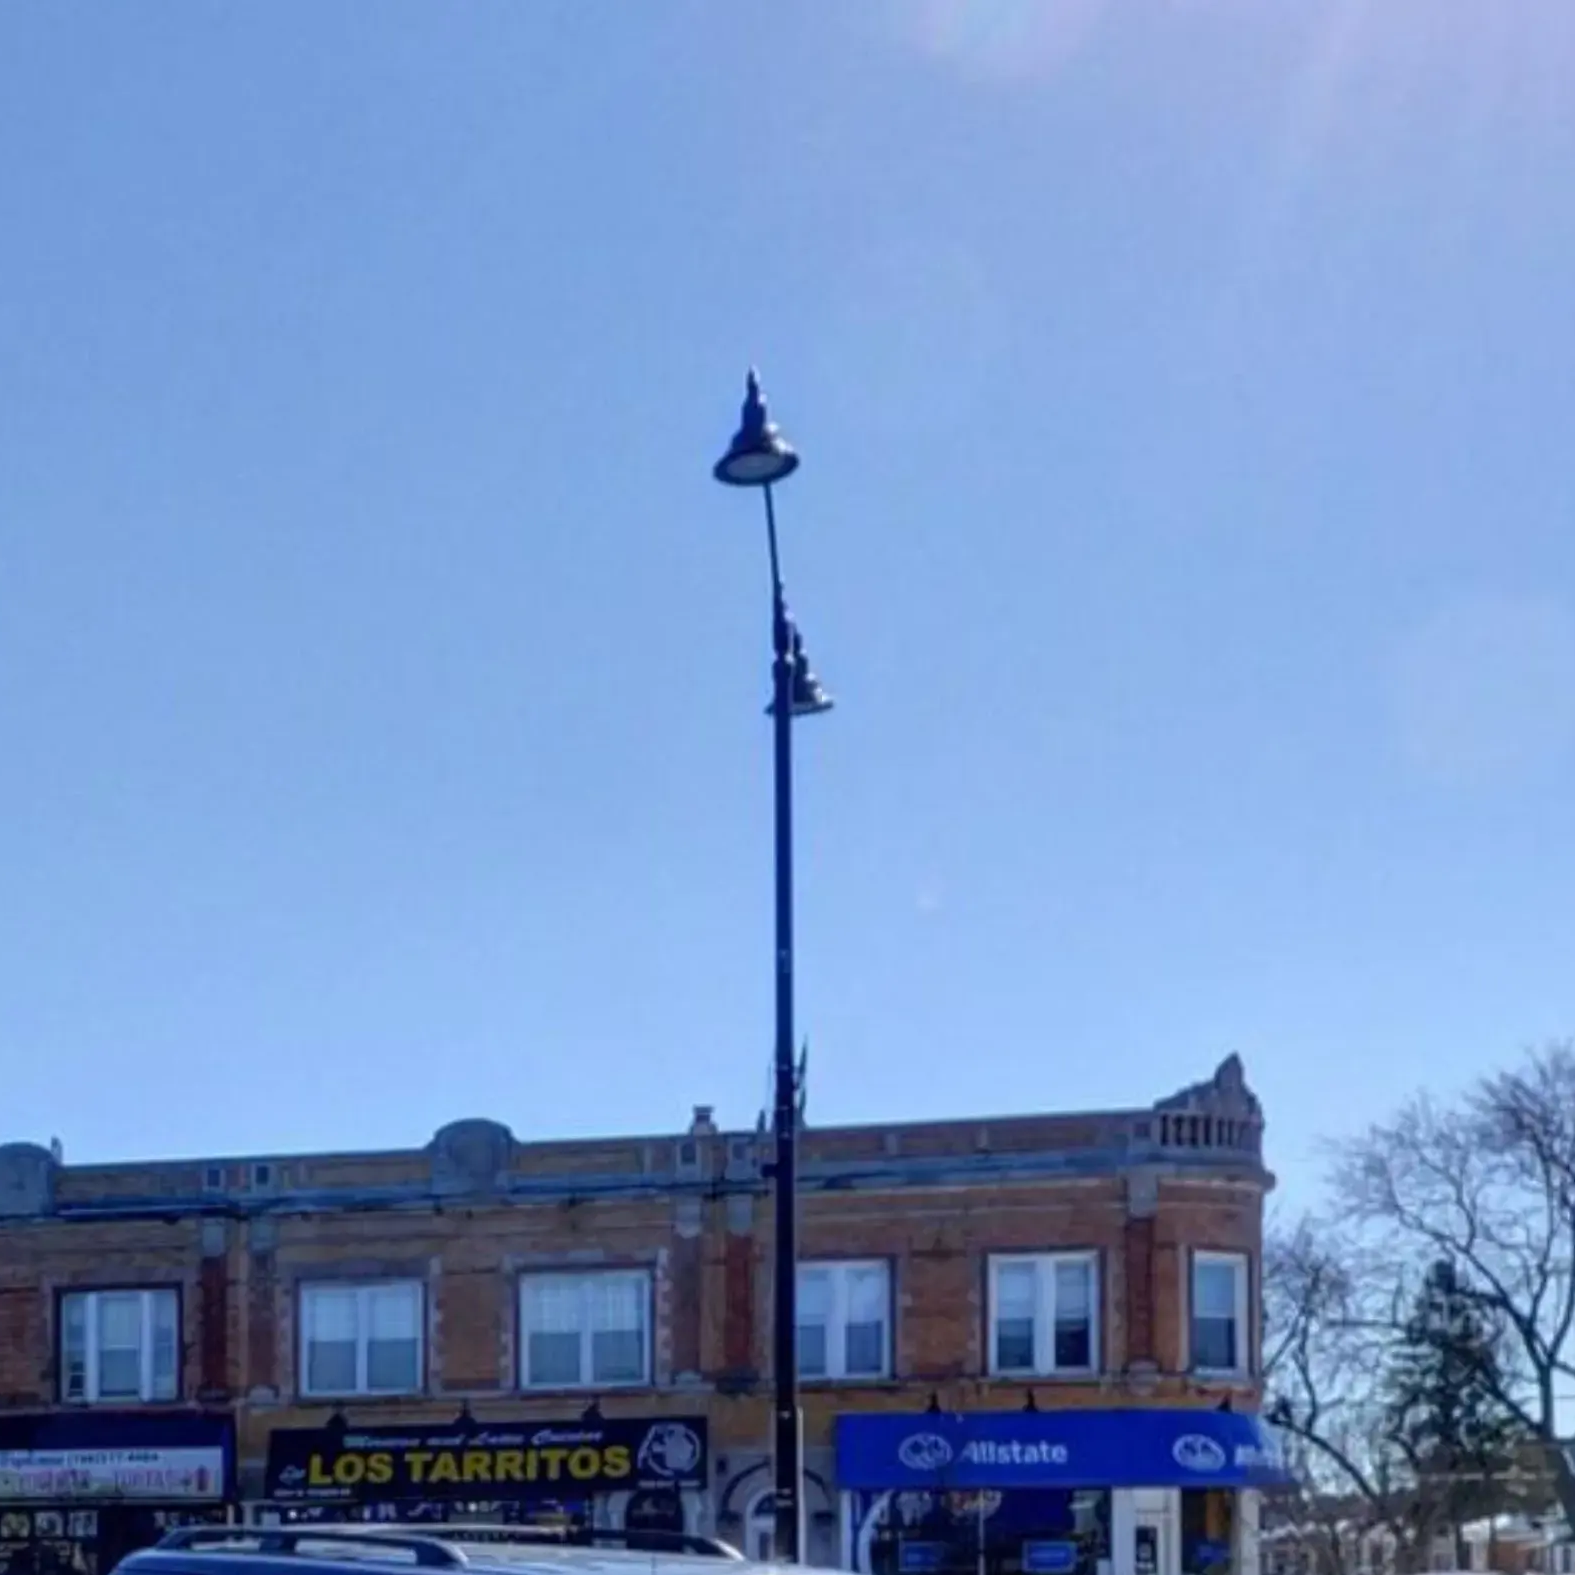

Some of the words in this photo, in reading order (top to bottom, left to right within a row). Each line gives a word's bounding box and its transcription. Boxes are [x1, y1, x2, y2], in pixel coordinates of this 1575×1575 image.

[308, 1453, 394, 1486] LOS
[404, 1445, 631, 1484] TARRITOS
[960, 1440, 1068, 1466] Allstate
